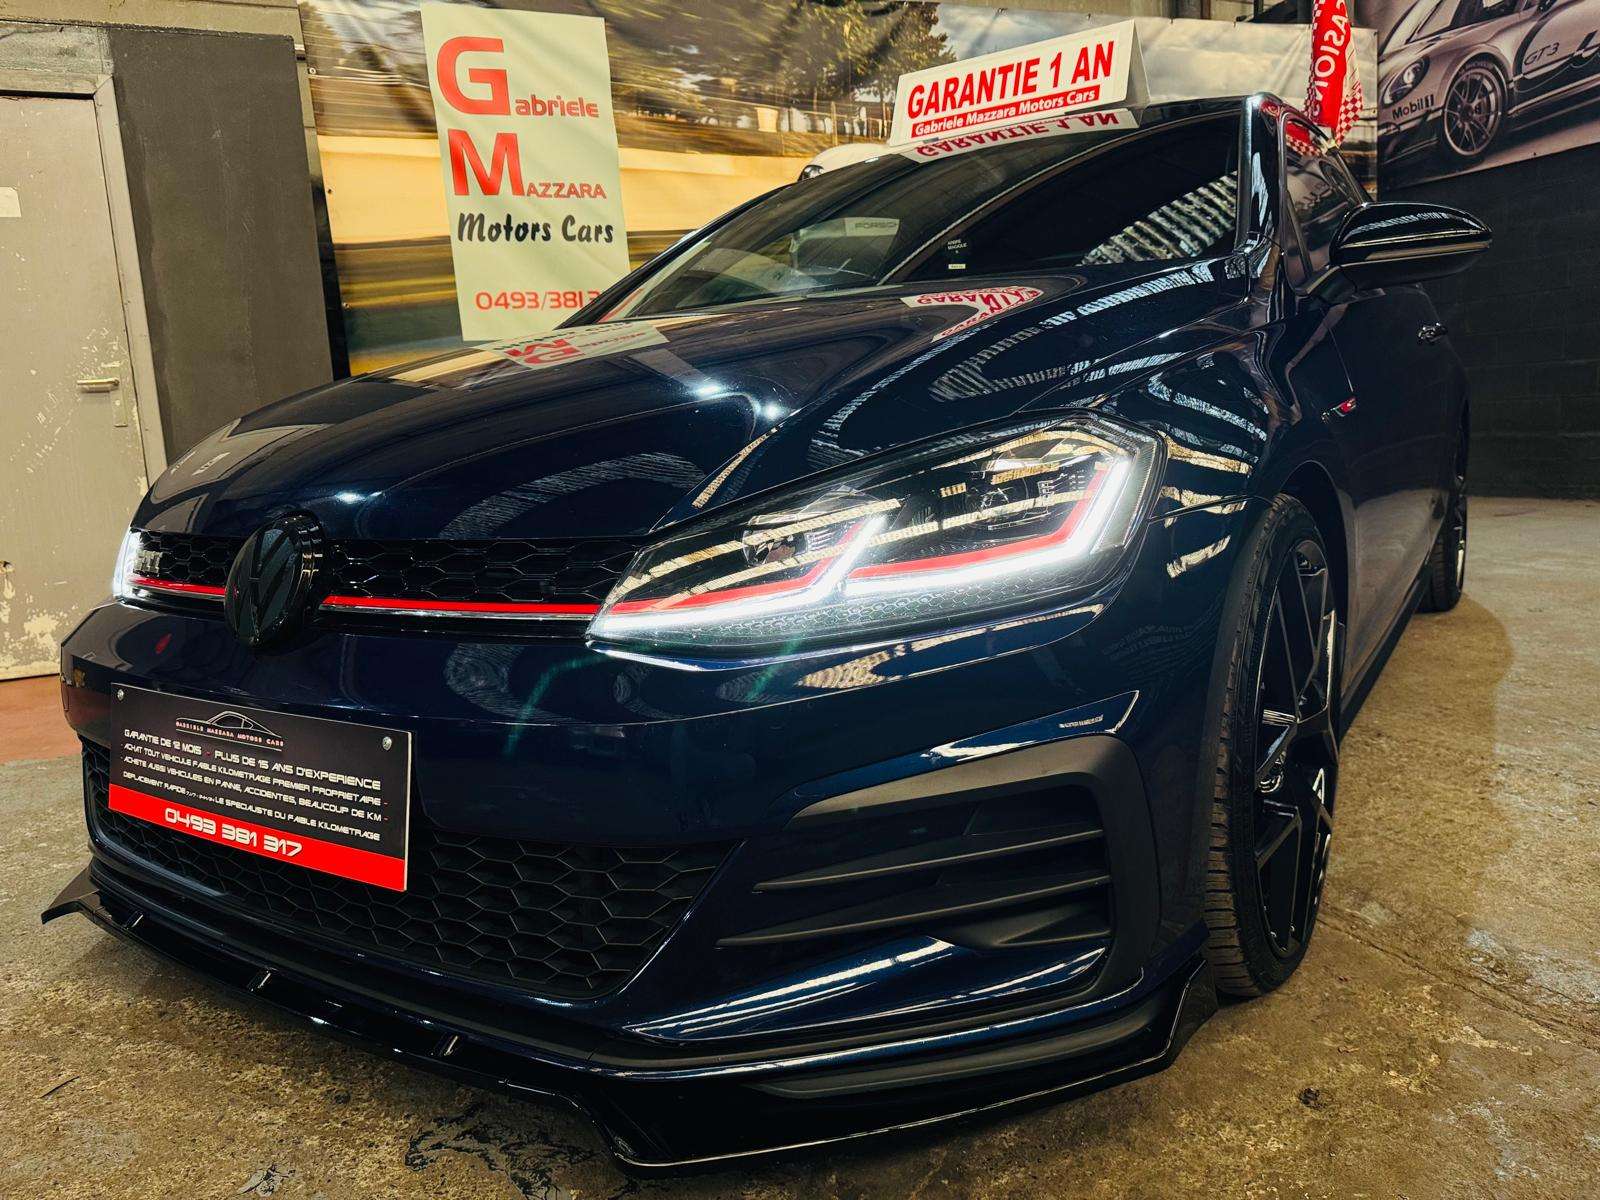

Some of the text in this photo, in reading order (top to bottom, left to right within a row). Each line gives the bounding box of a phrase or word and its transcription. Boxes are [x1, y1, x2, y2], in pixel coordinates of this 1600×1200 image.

[437, 36, 600, 118] Gabriele
[907, 40, 1115, 120] GARANTIE 1 AN
[1523, 42, 1560, 66] GT3
[915, 88, 1096, 137] Gabriele Mazzara Motors Cars
[1392, 98, 1423, 120] Mobil
[447, 128, 607, 200] MAZZARA
[457, 212, 614, 243] Motors Cars
[124, 729, 381, 790] GARANTIE DE 12 MOIS PLUS DE 15 ANS D'EXPERIENCE
[124, 743, 142, 754] ACHAT
[144, 747, 160, 759] TOUT
[161, 752, 192, 766] VEHICULE
[218, 766, 271, 784] KILOMETRAGE
[272, 778, 310, 792] PREMIER
[123, 771, 163, 787] DEPLACEMENT
[164, 781, 186, 795] RAPIDE
[215, 797, 224, 805] LE
[225, 799, 273, 817] SPECIALISTE
[274, 810, 286, 820] DU
[287, 814, 316, 827] FAIBLE
[318, 820, 380, 841] KILOMETRAGE
[124, 756, 147, 768] ACHETE
[148, 762, 166, 773] AUSSI
[167, 767, 203, 782] VEHICULES
[204, 776, 214, 785] EN
[244, 786, 297, 805] ACCIDENTES,
[298, 797, 348, 814] BEAUCOUP
[351, 808, 365, 818] DE
[367, 811, 382, 822] KM
[164, 807, 303, 857] 0493 381 317
